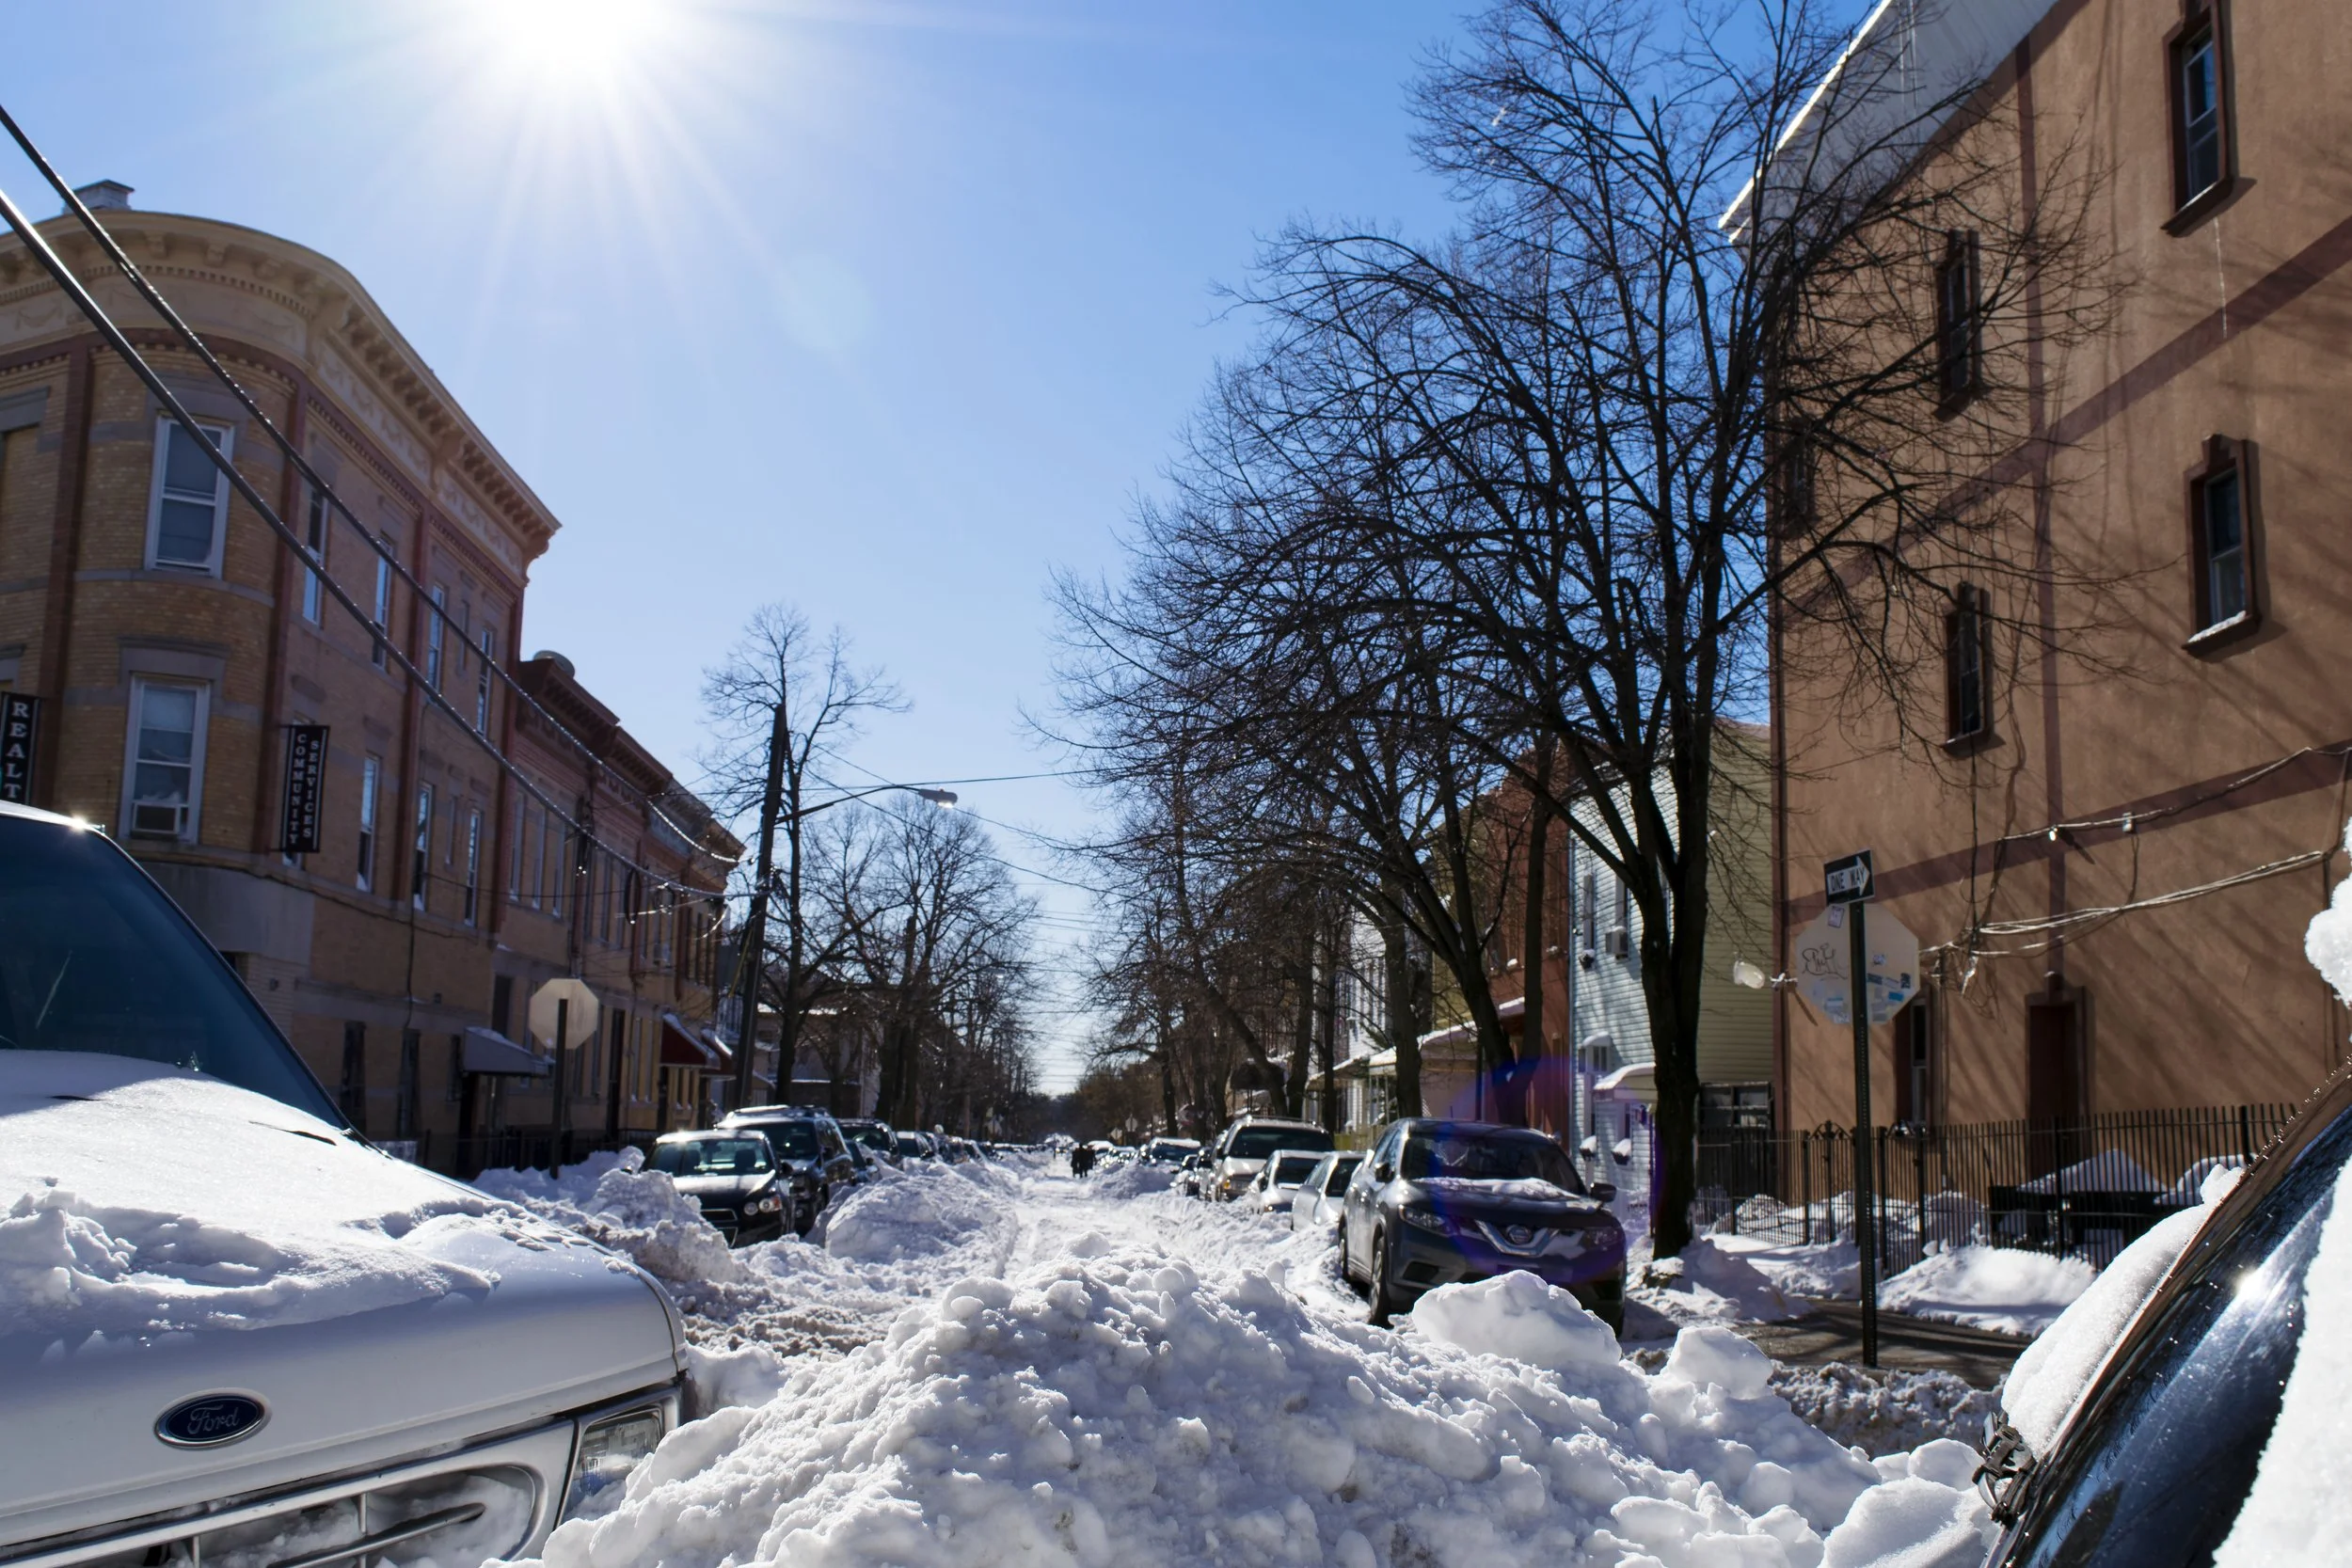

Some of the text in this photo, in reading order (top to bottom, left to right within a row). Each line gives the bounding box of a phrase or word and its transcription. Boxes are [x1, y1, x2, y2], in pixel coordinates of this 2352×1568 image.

[4, 701, 29, 799] REALT
[290, 734, 307, 844] COMMUNITY
[303, 740, 319, 837] SERVICES
[1831, 866, 1866, 892] ONE WAY
[187, 1404, 239, 1434] Ford
